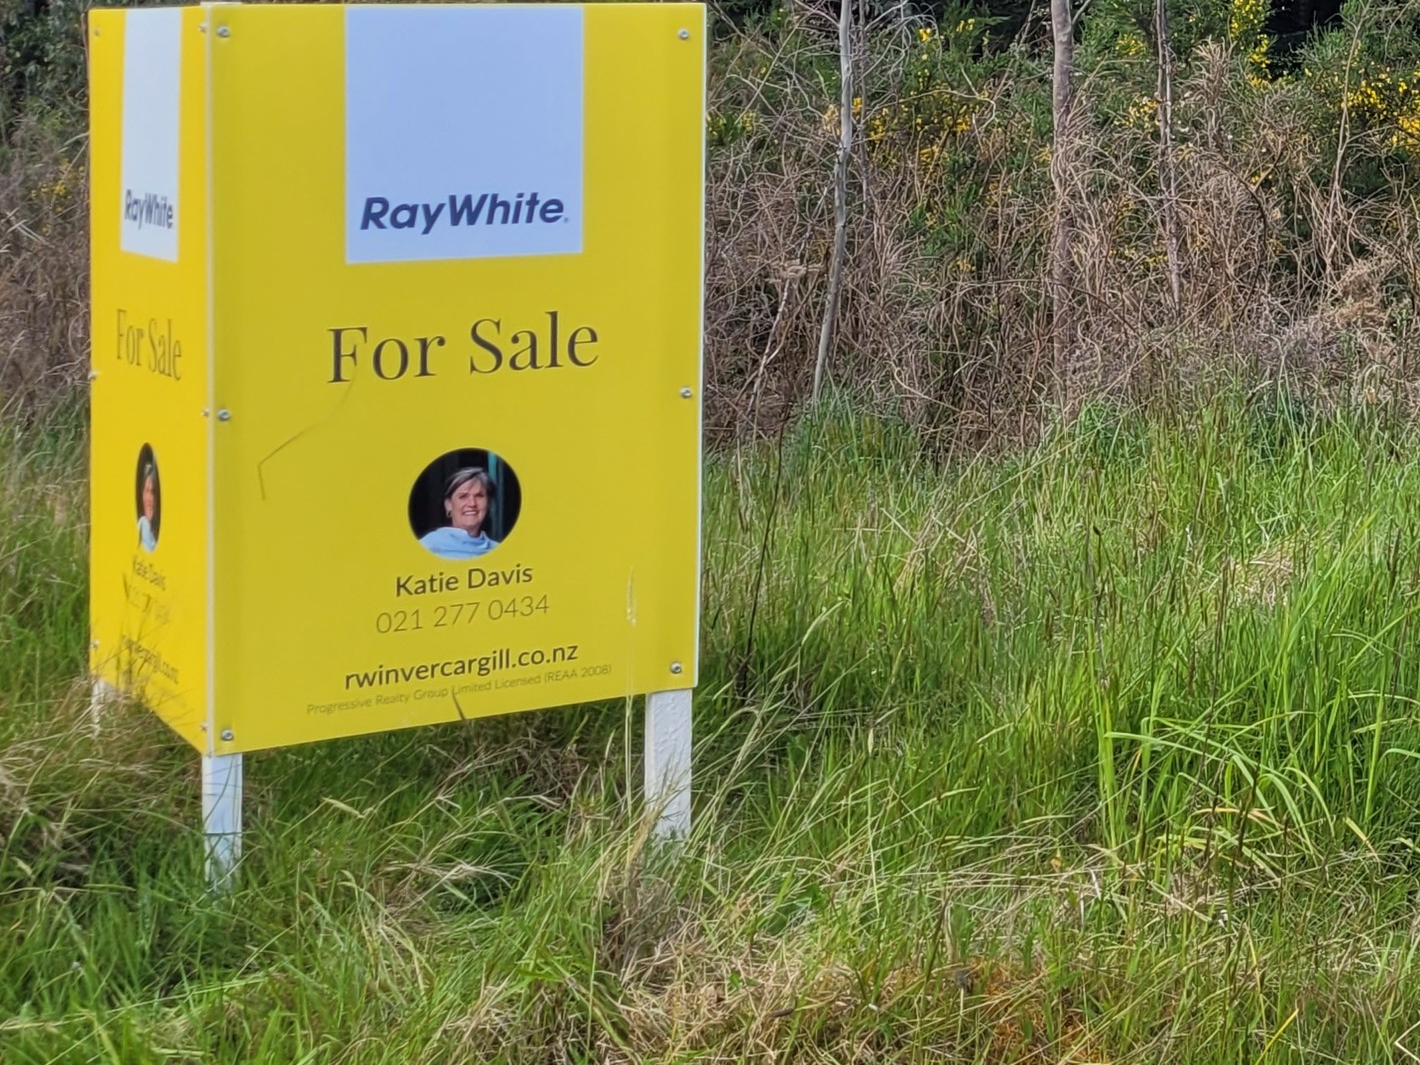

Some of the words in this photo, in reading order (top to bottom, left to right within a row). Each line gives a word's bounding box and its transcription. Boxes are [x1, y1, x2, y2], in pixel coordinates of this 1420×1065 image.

[116, 309, 144, 367] For
[148, 317, 182, 381] Sale
[327, 327, 446, 383] For
[469, 310, 599, 375] Sale
[396, 572, 459, 597] Katie
[467, 563, 533, 589] Davis
[375, 609, 424, 634] 021
[433, 602, 480, 628] 277
[487, 594, 550, 621] 0434
[345, 644, 578, 690] rwinvercargill.co.nz
[306, 697, 373, 715] Progressive
[375, 691, 410, 707] Realty
[413, 686, 449, 701] Group
[451, 681, 492, 696] Limited
[494, 673, 542, 690] Licensed
[543, 669, 578, 685] (REAA
